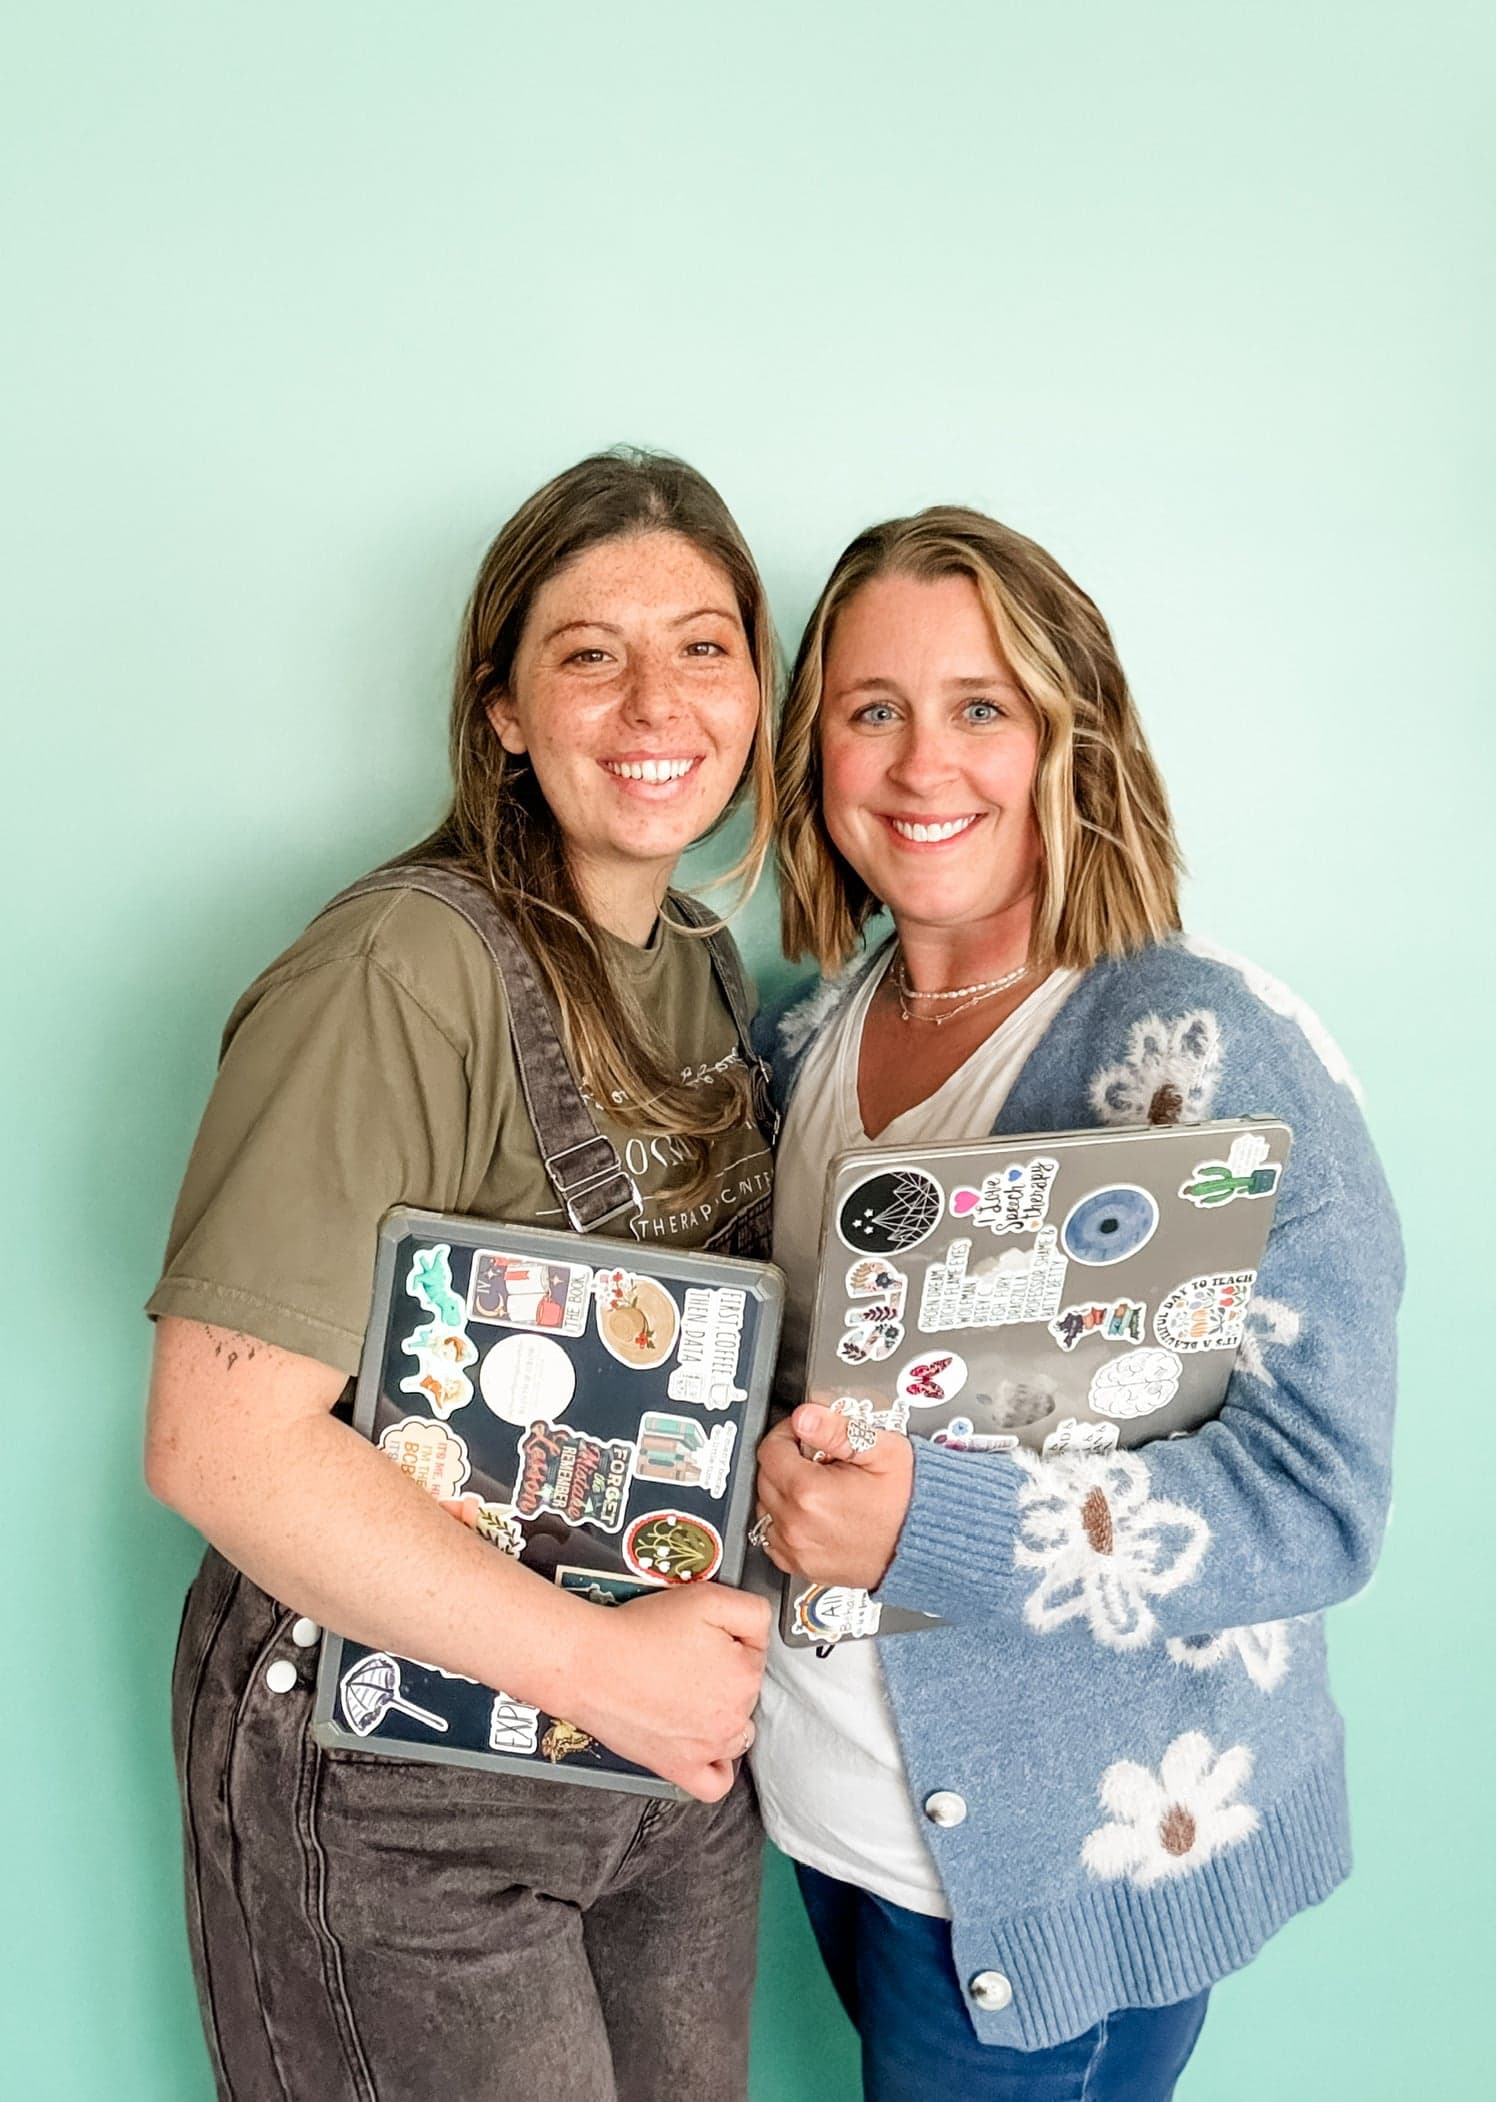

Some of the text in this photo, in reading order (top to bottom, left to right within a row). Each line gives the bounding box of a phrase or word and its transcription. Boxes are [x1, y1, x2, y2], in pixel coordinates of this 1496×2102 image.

[1020, 1162, 1054, 1219] therapy
[638, 1200, 719, 1238] THERAP
[564, 1274, 585, 1328] THE BOOK
[1163, 1287, 1188, 1309] DAY
[1192, 1280, 1207, 1290] TO
[1211, 1274, 1253, 1286] TEACH
[681, 1330, 705, 1362] DATA
[712, 1332, 737, 1375] COFFEE
[552, 1446, 577, 1508] REMEMBER
[567, 1444, 601, 1521] Mistake
[600, 1447, 628, 1525] FORGET
